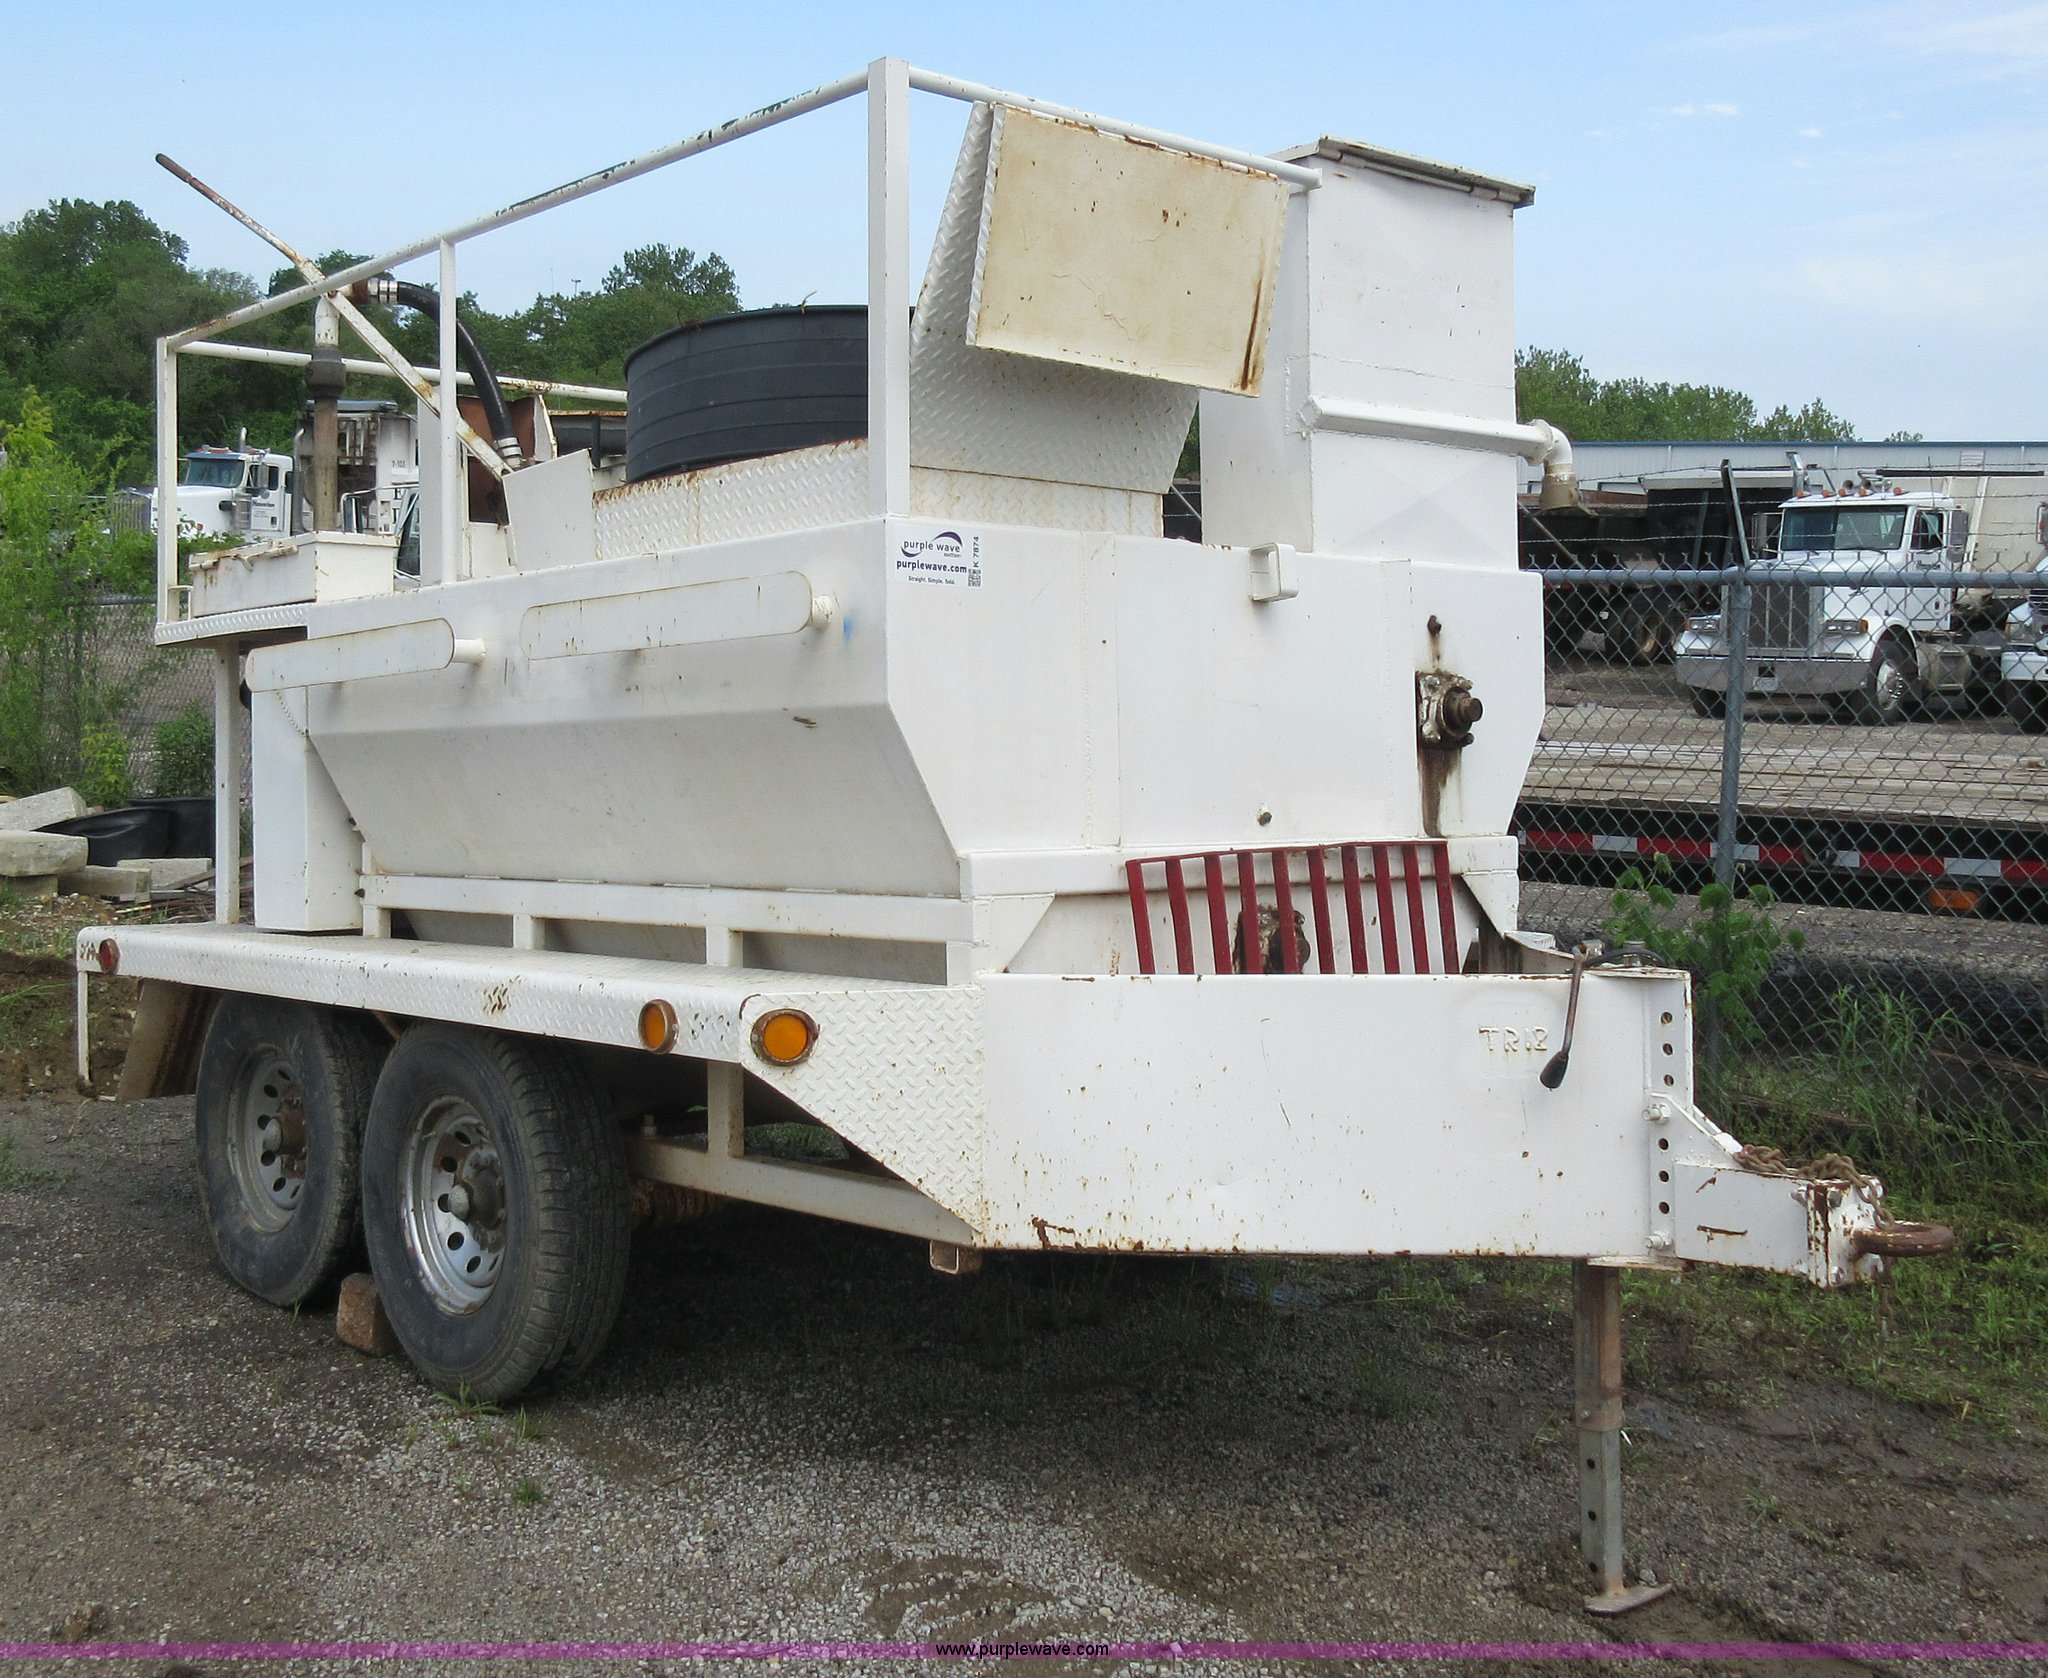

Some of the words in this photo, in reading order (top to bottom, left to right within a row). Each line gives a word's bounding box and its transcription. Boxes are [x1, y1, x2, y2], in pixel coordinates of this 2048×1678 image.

[903, 540, 933, 551] purple
[936, 543, 960, 552] wave
[896, 559, 967, 573] purplewave.com
